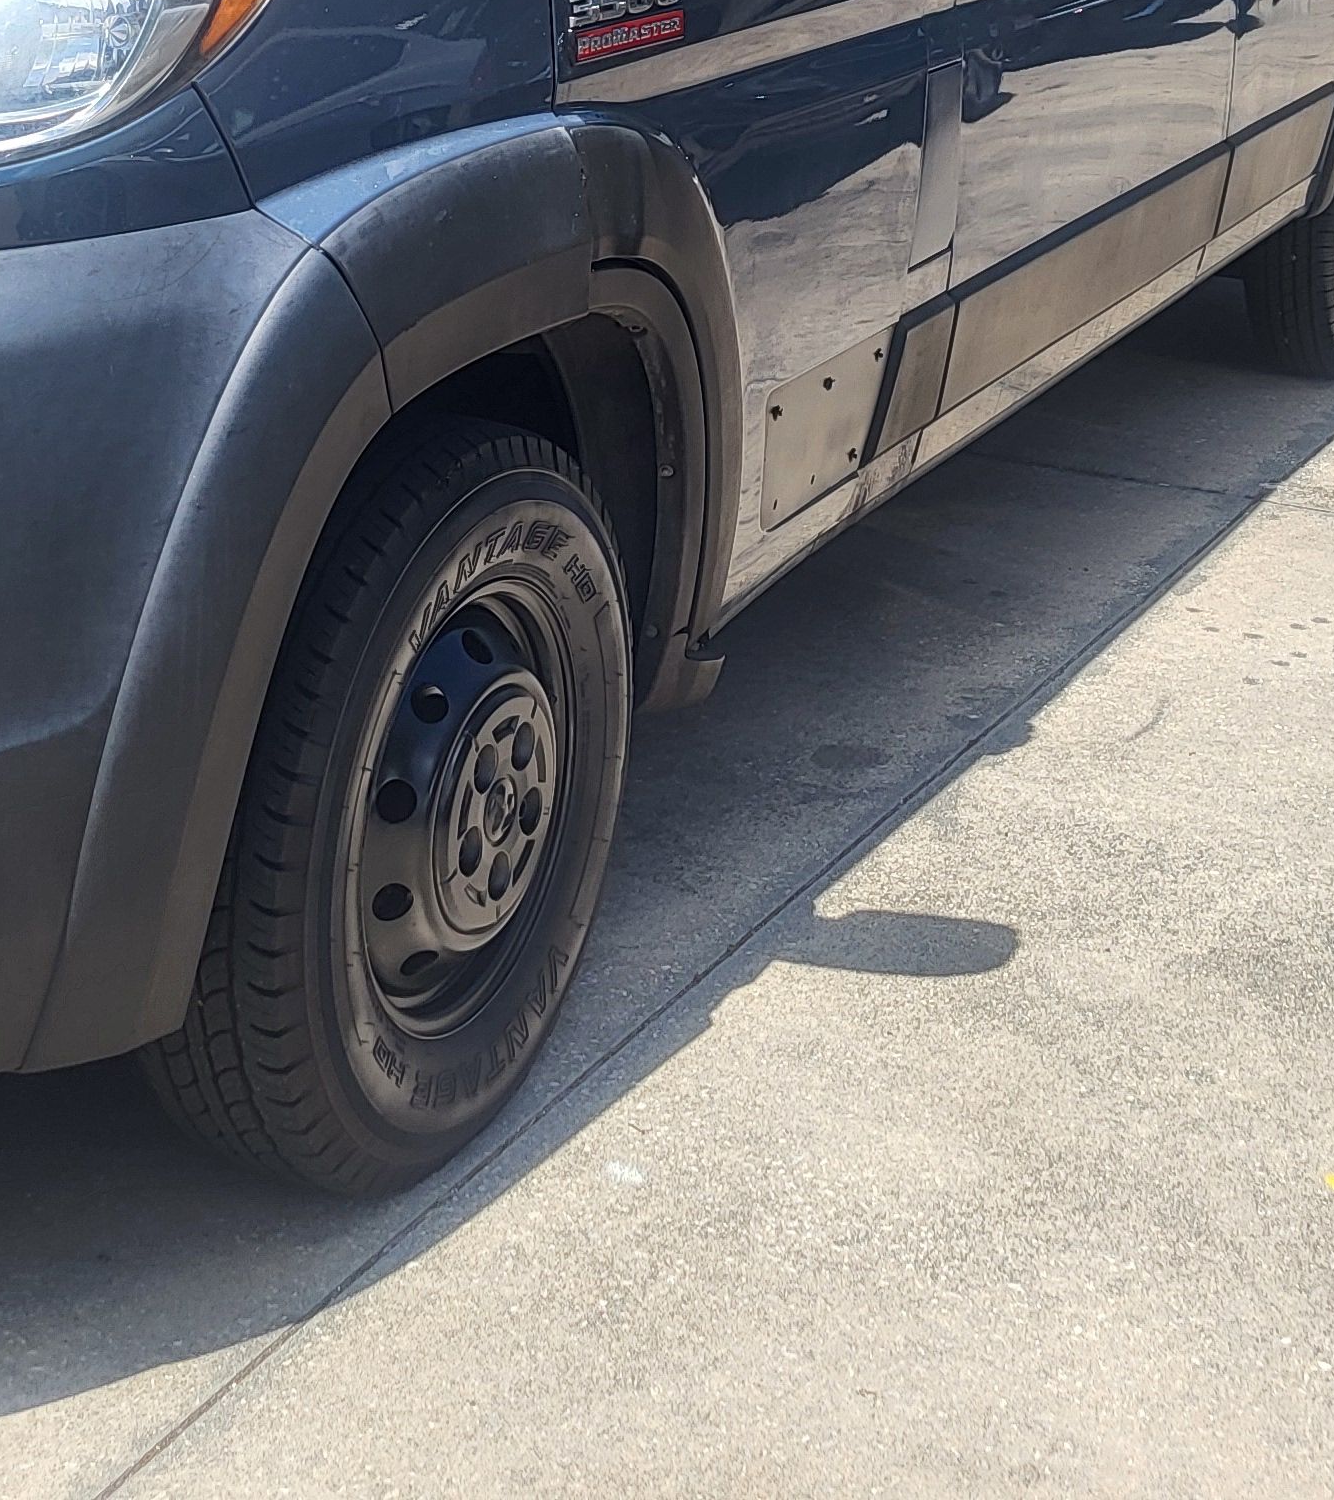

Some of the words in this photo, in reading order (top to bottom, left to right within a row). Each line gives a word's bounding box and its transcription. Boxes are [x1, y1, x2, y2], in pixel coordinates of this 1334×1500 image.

[408, 520, 573, 653] VANTAGE
[562, 553, 599, 605] HD
[372, 1035, 408, 1089] HD
